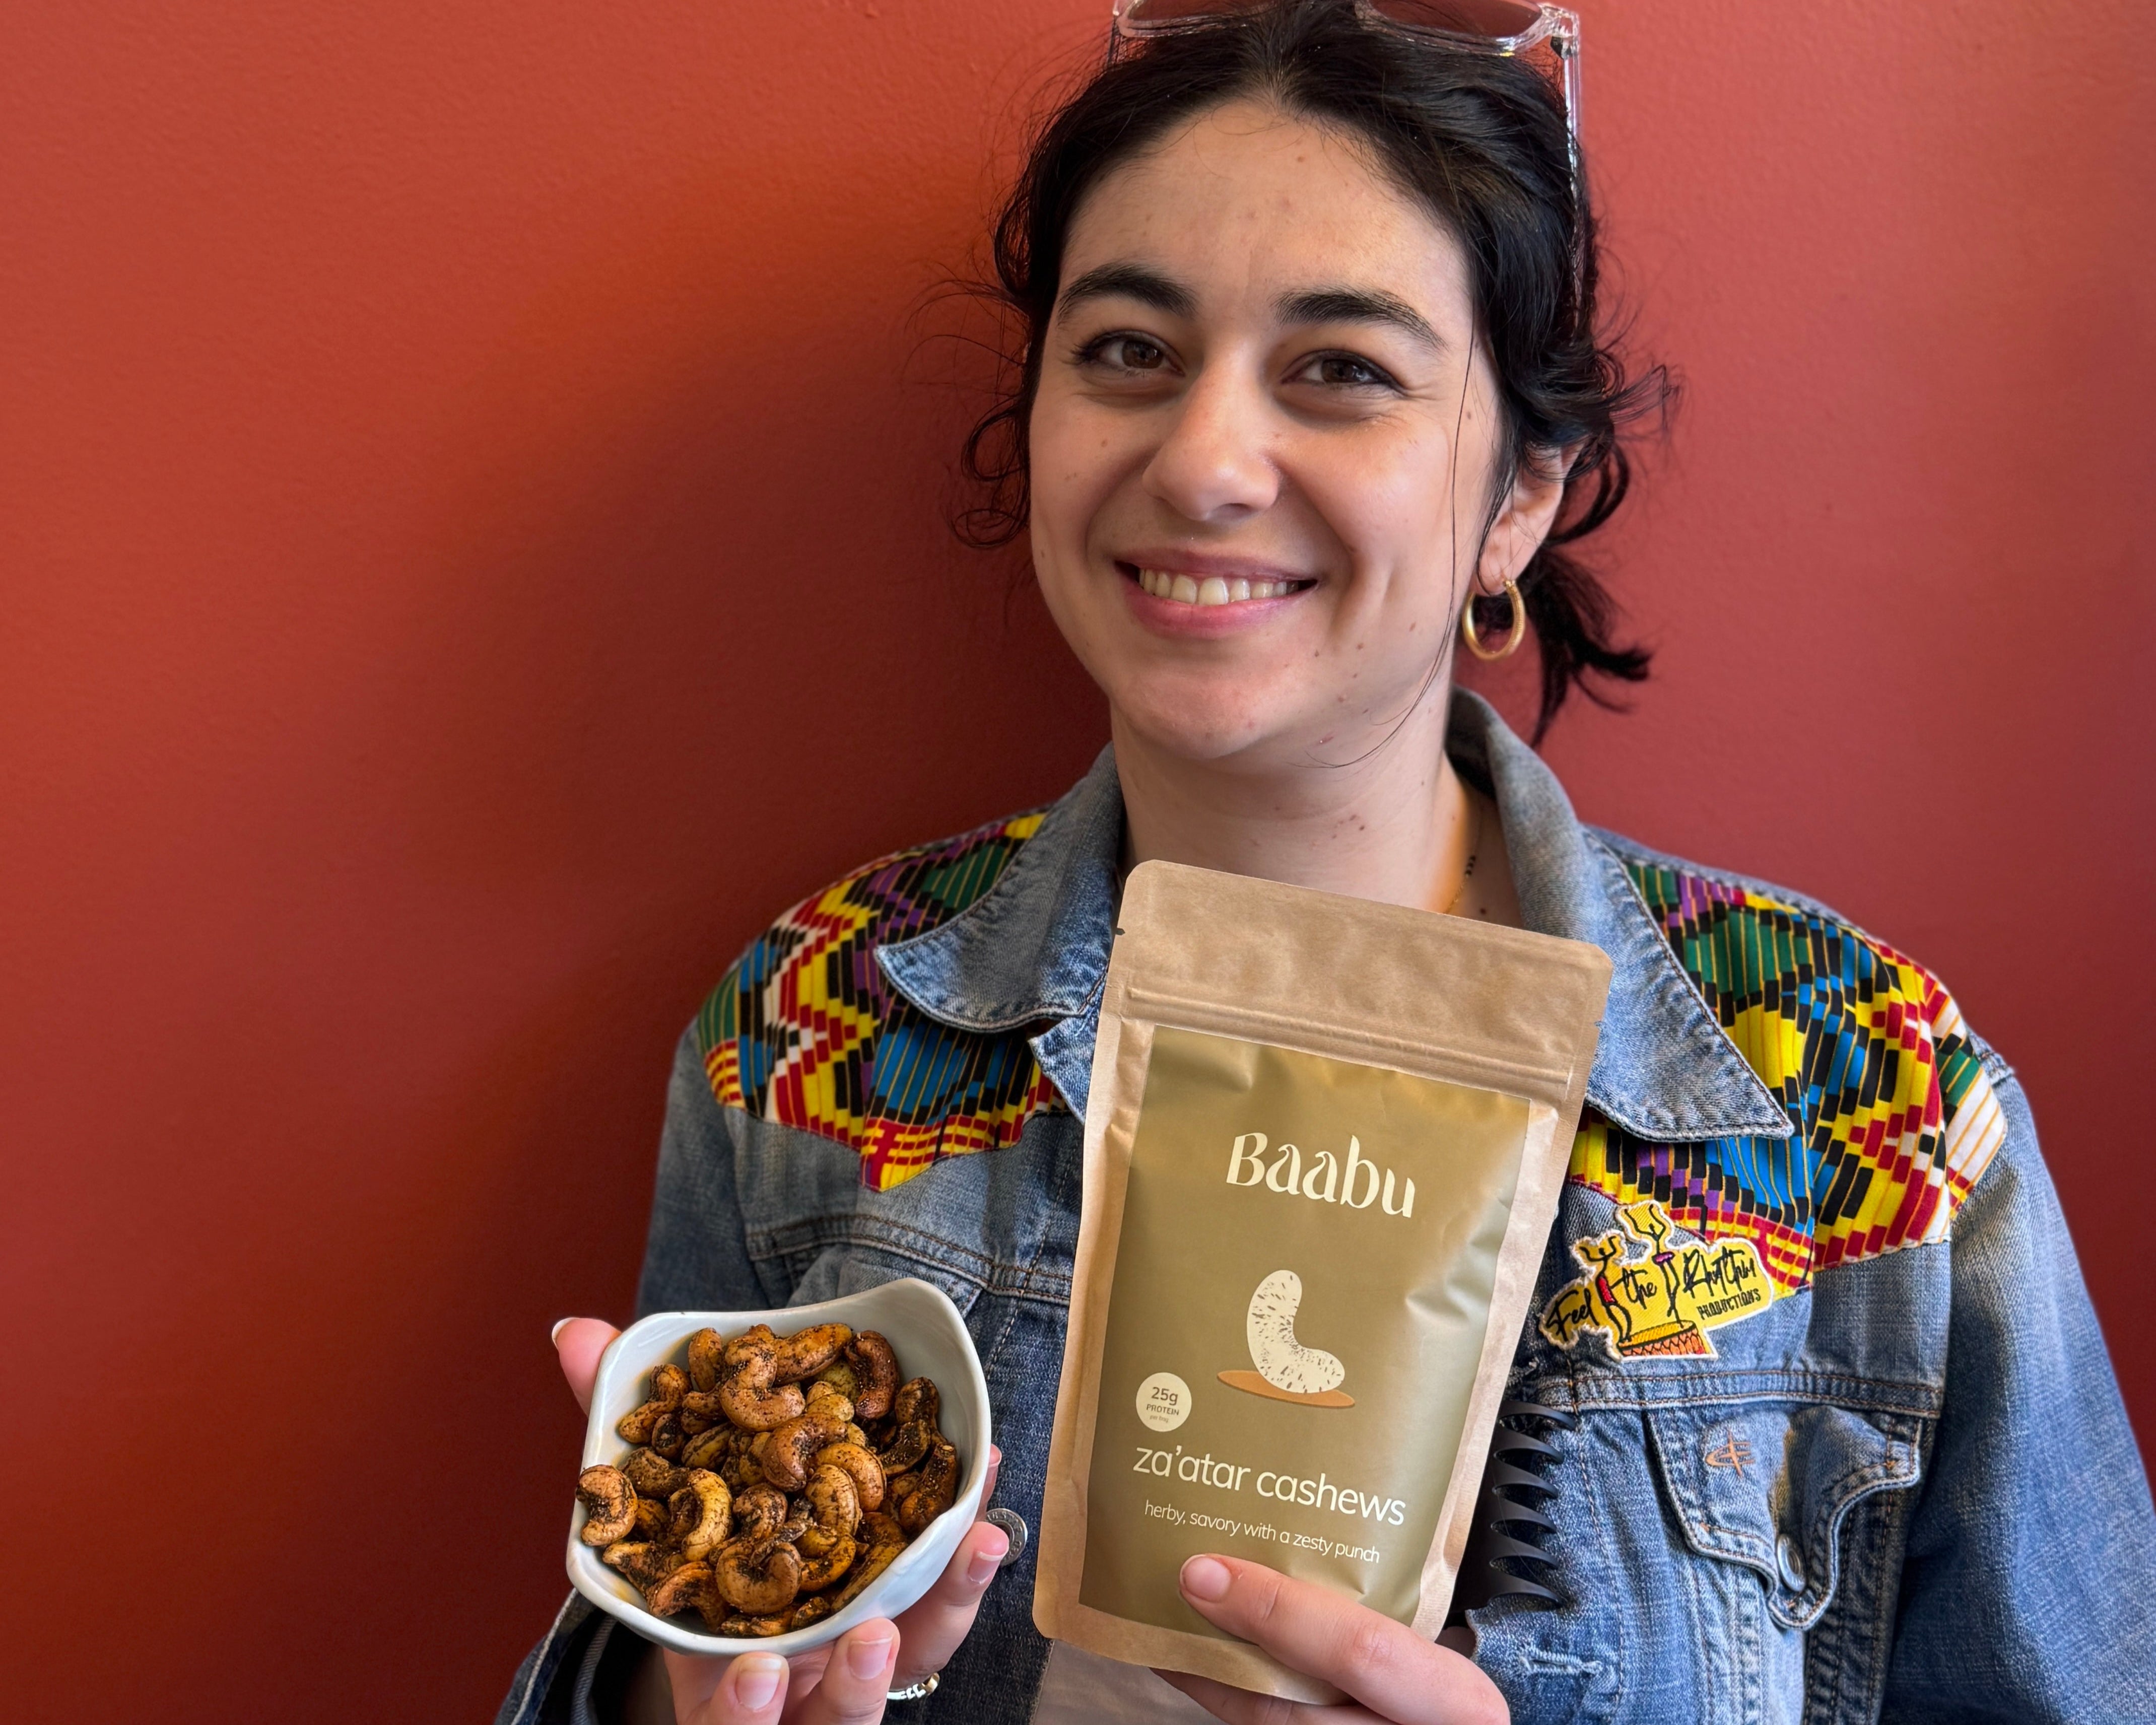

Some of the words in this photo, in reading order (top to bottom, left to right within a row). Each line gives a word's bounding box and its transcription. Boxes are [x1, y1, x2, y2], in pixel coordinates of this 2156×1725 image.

[1226, 1132, 1416, 1218] Baabu
[1545, 1287, 1599, 1341] Feel
[1611, 1267, 1657, 1309] the
[1697, 1288, 1761, 1320] PRODUCTIONS
[1146, 1404, 1179, 1415] PROTEIN
[1152, 1387, 1178, 1405] 25g
[1256, 1471, 1406, 1526] cashews
[1144, 1499, 1186, 1525] herby,
[1189, 1510, 1241, 1537] savory
[1244, 1523, 1276, 1541] with
[1279, 1531, 1290, 1544] a
[1293, 1533, 1333, 1556] zesty
[1334, 1542, 1380, 1564] punch
